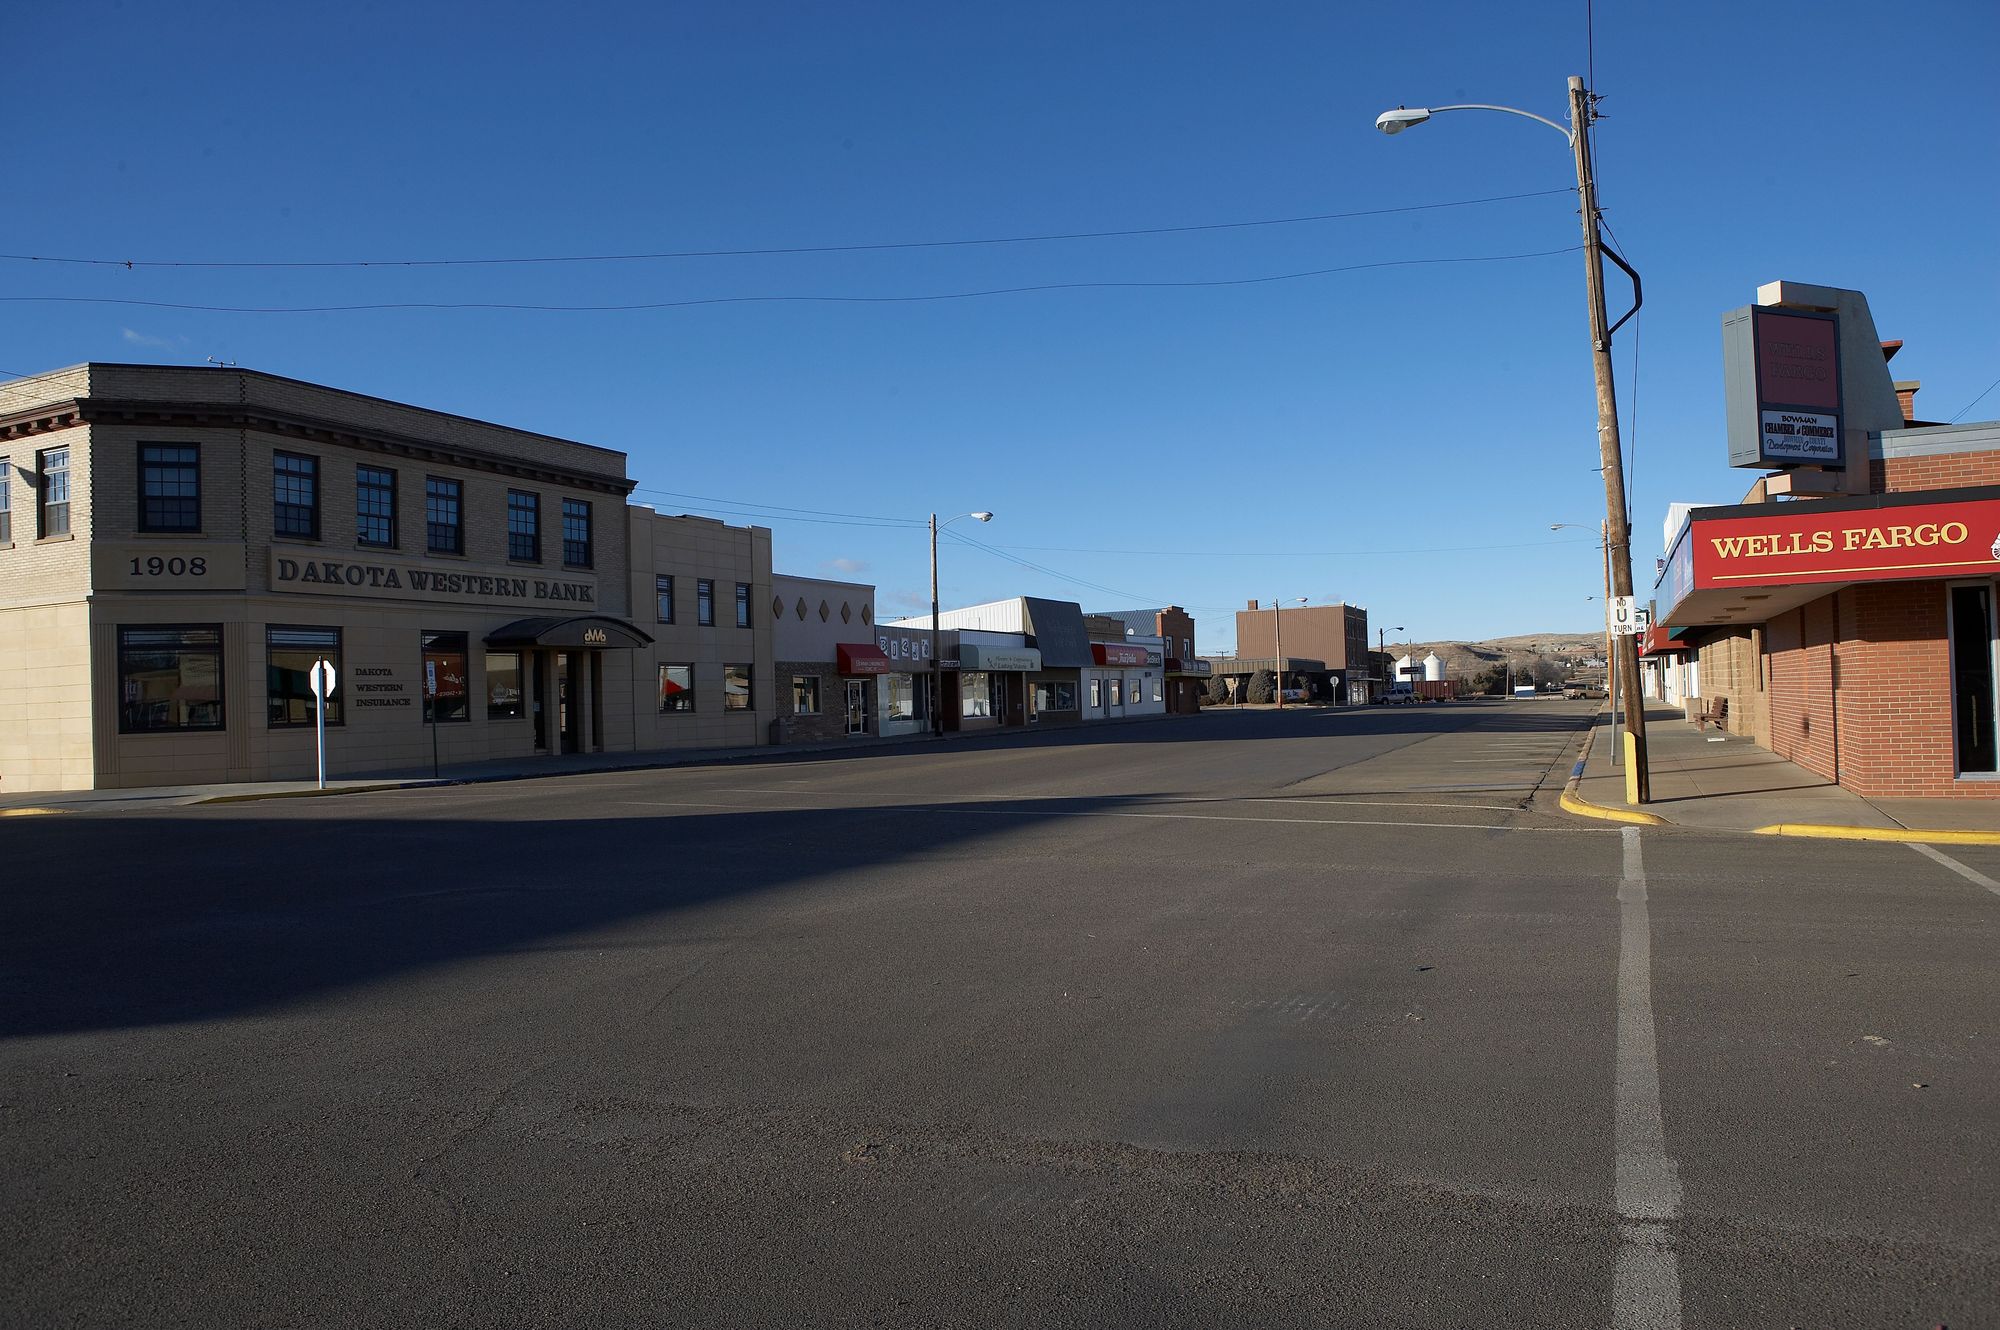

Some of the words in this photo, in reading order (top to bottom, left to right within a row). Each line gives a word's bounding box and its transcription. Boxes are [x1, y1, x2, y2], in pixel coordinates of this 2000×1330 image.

[1781, 415, 1817, 425] BOWMAN
[1765, 423, 1795, 435] CHAMBER
[1801, 426, 1834, 438] COMMERCE
[1711, 531, 1834, 559] WELLS
[1842, 522, 1968, 551] FARGO
[130, 557, 207, 576] 1908
[278, 558, 402, 589] DAKOTA
[408, 569, 528, 597] WESTERN
[534, 580, 594, 603] BANK
[1617, 609, 1627, 622] U
[1613, 624, 1632, 633] TURN
[355, 668, 393, 676] DAKOTA
[356, 684, 403, 692] WESTERN
[356, 698, 411, 707] INSURANCE
